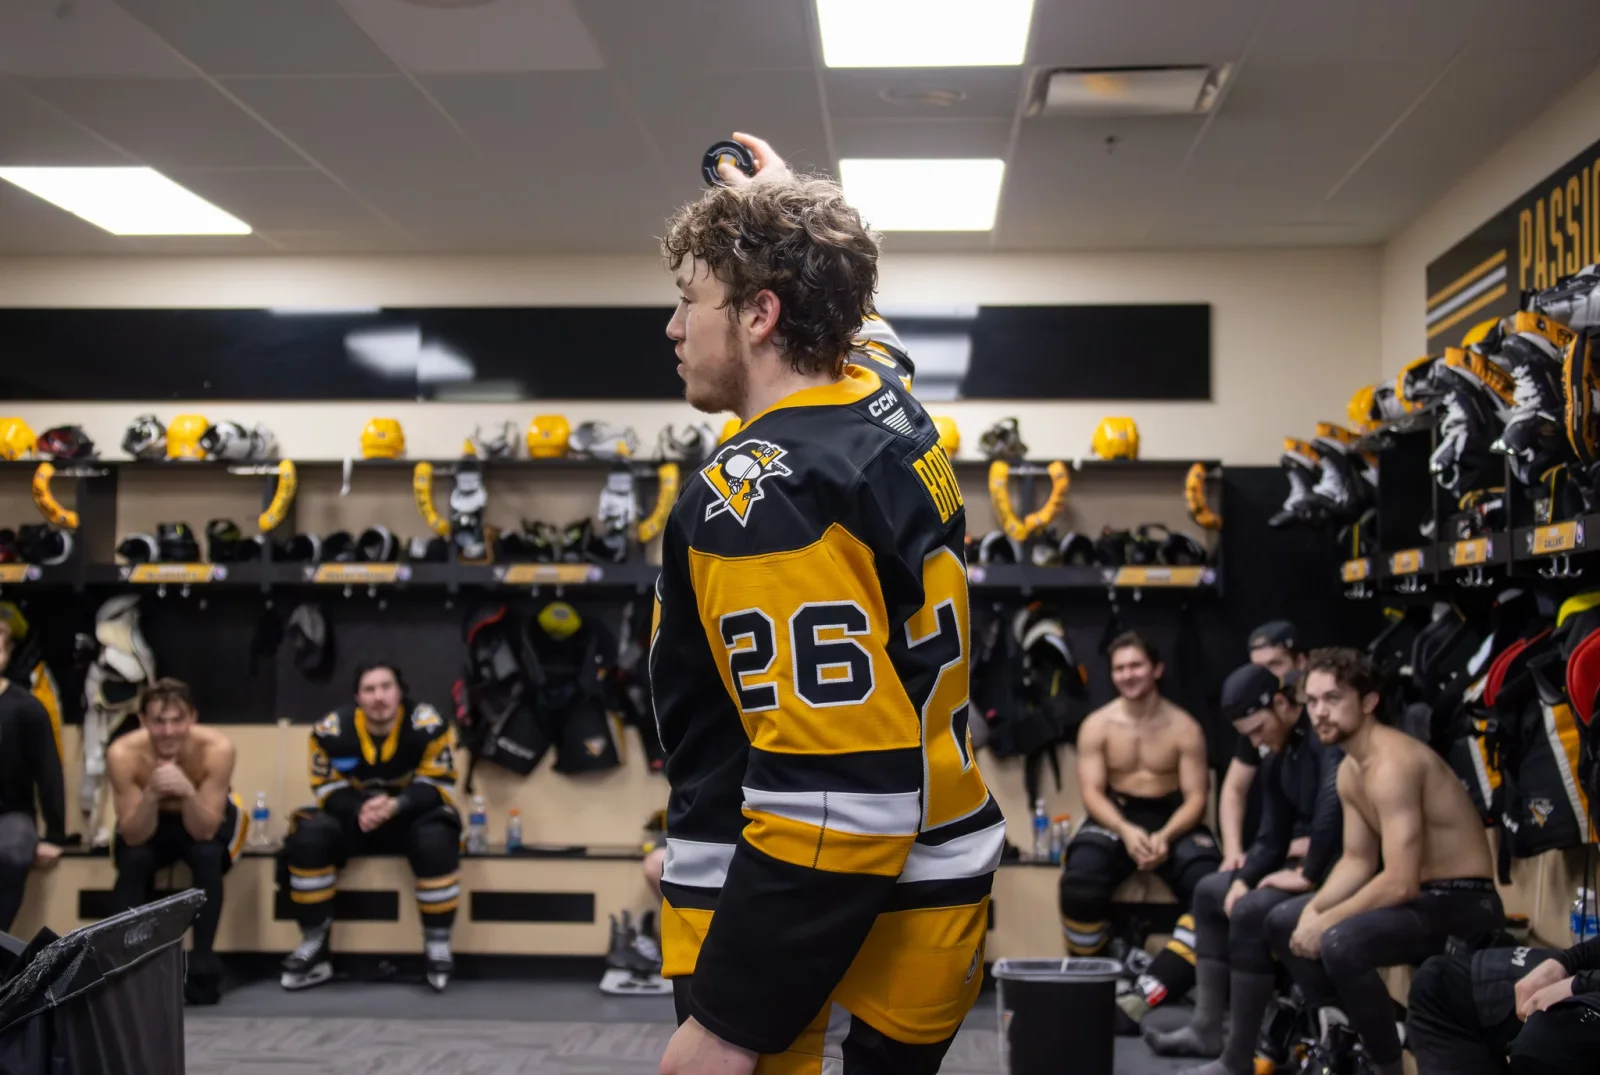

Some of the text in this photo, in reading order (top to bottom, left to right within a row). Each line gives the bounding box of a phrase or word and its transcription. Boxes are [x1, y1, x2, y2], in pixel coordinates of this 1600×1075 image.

[868, 390, 898, 418] CCM
[912, 438, 965, 524] BRO
[719, 600, 876, 713] 26
